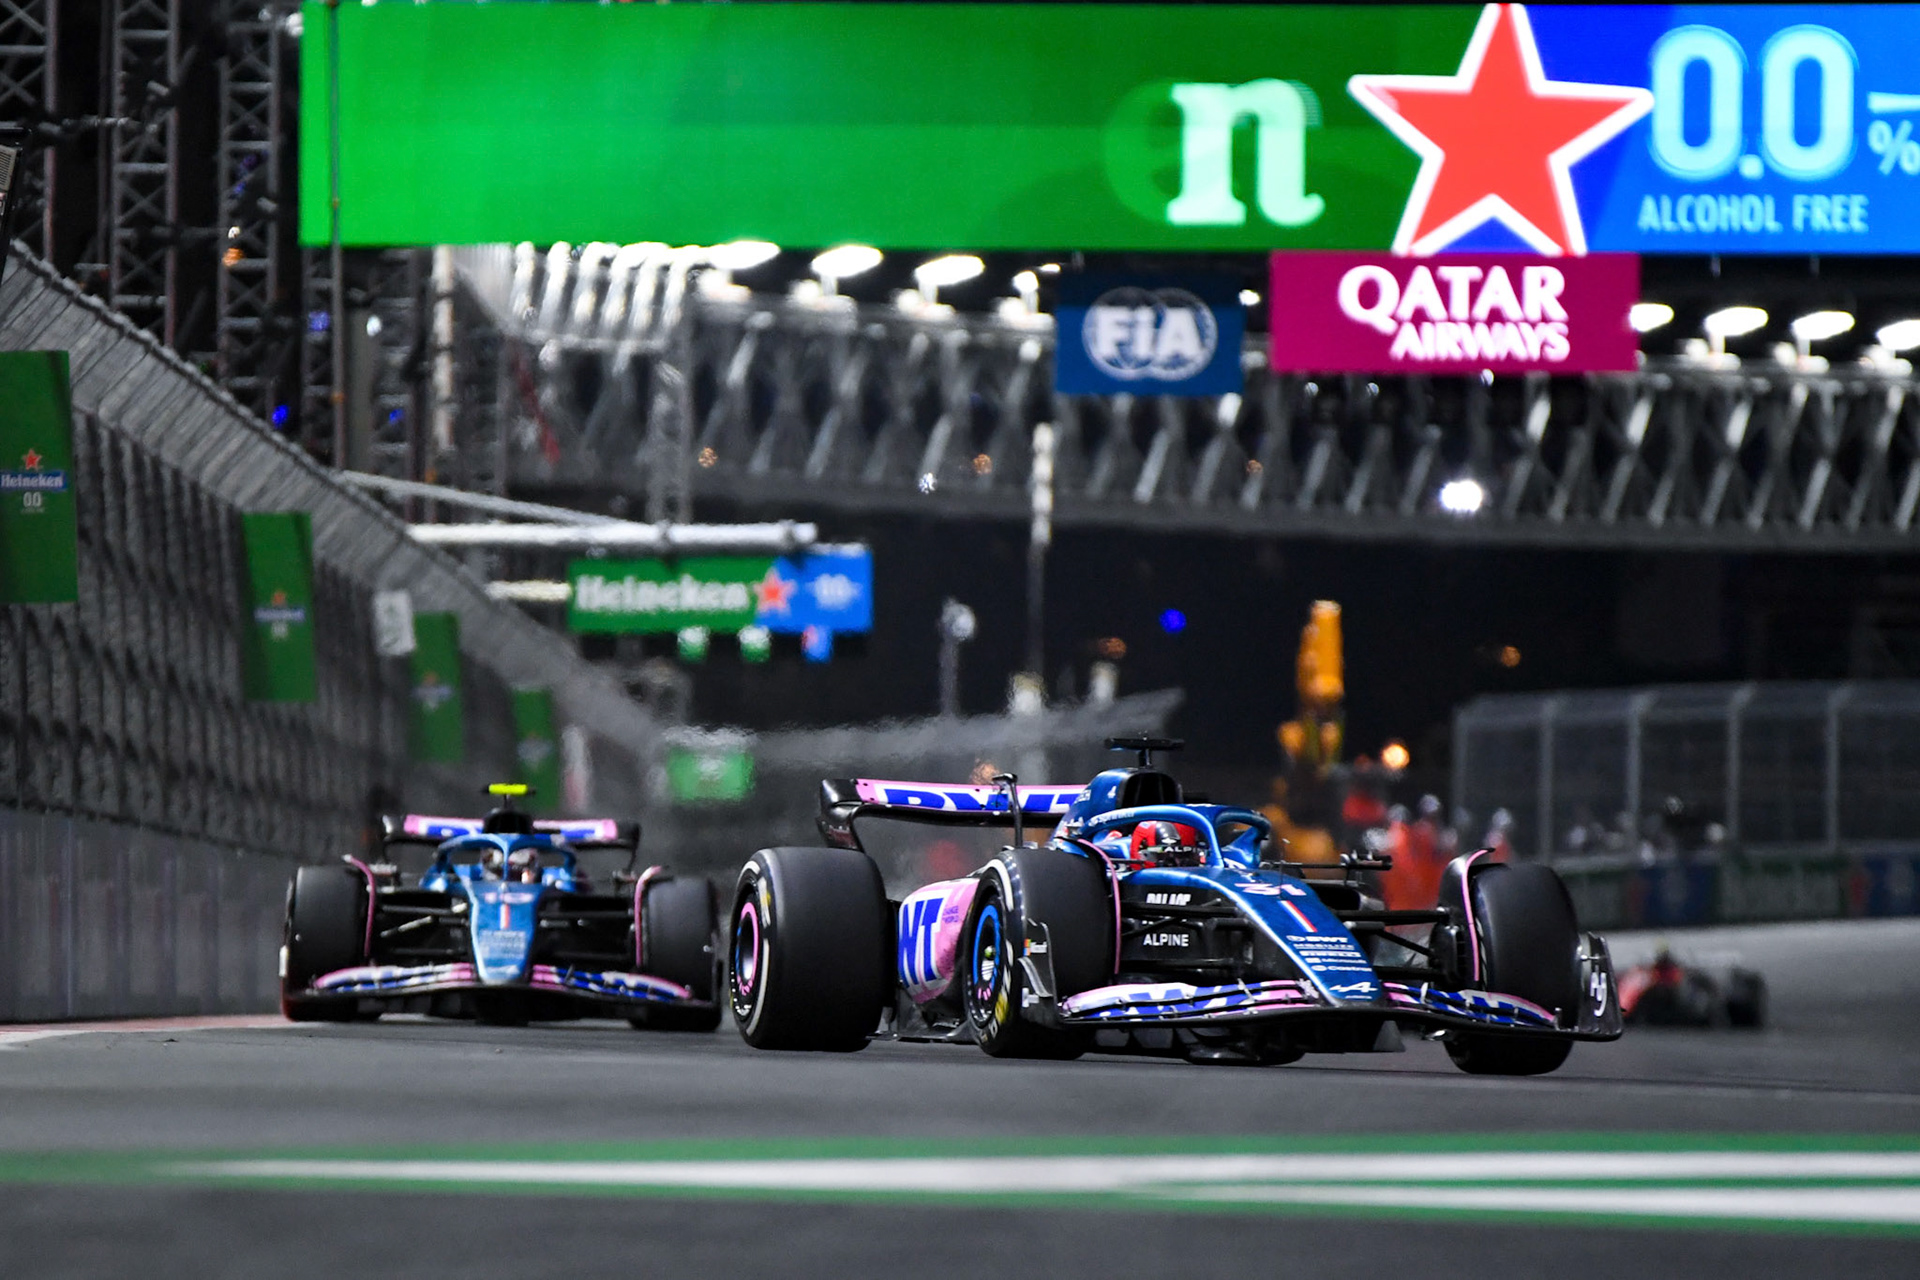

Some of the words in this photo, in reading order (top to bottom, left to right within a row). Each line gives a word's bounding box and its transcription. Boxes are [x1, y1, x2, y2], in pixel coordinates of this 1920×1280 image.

[1637, 194, 1784, 233] ALCOHOL
[1792, 194, 1869, 233] FREE
[1338, 264, 1568, 335] QATAR
[1390, 321, 1571, 361] AIRWAYS
[1, 473, 64, 488] Heineken
[1143, 933, 1190, 947] ALPINE
